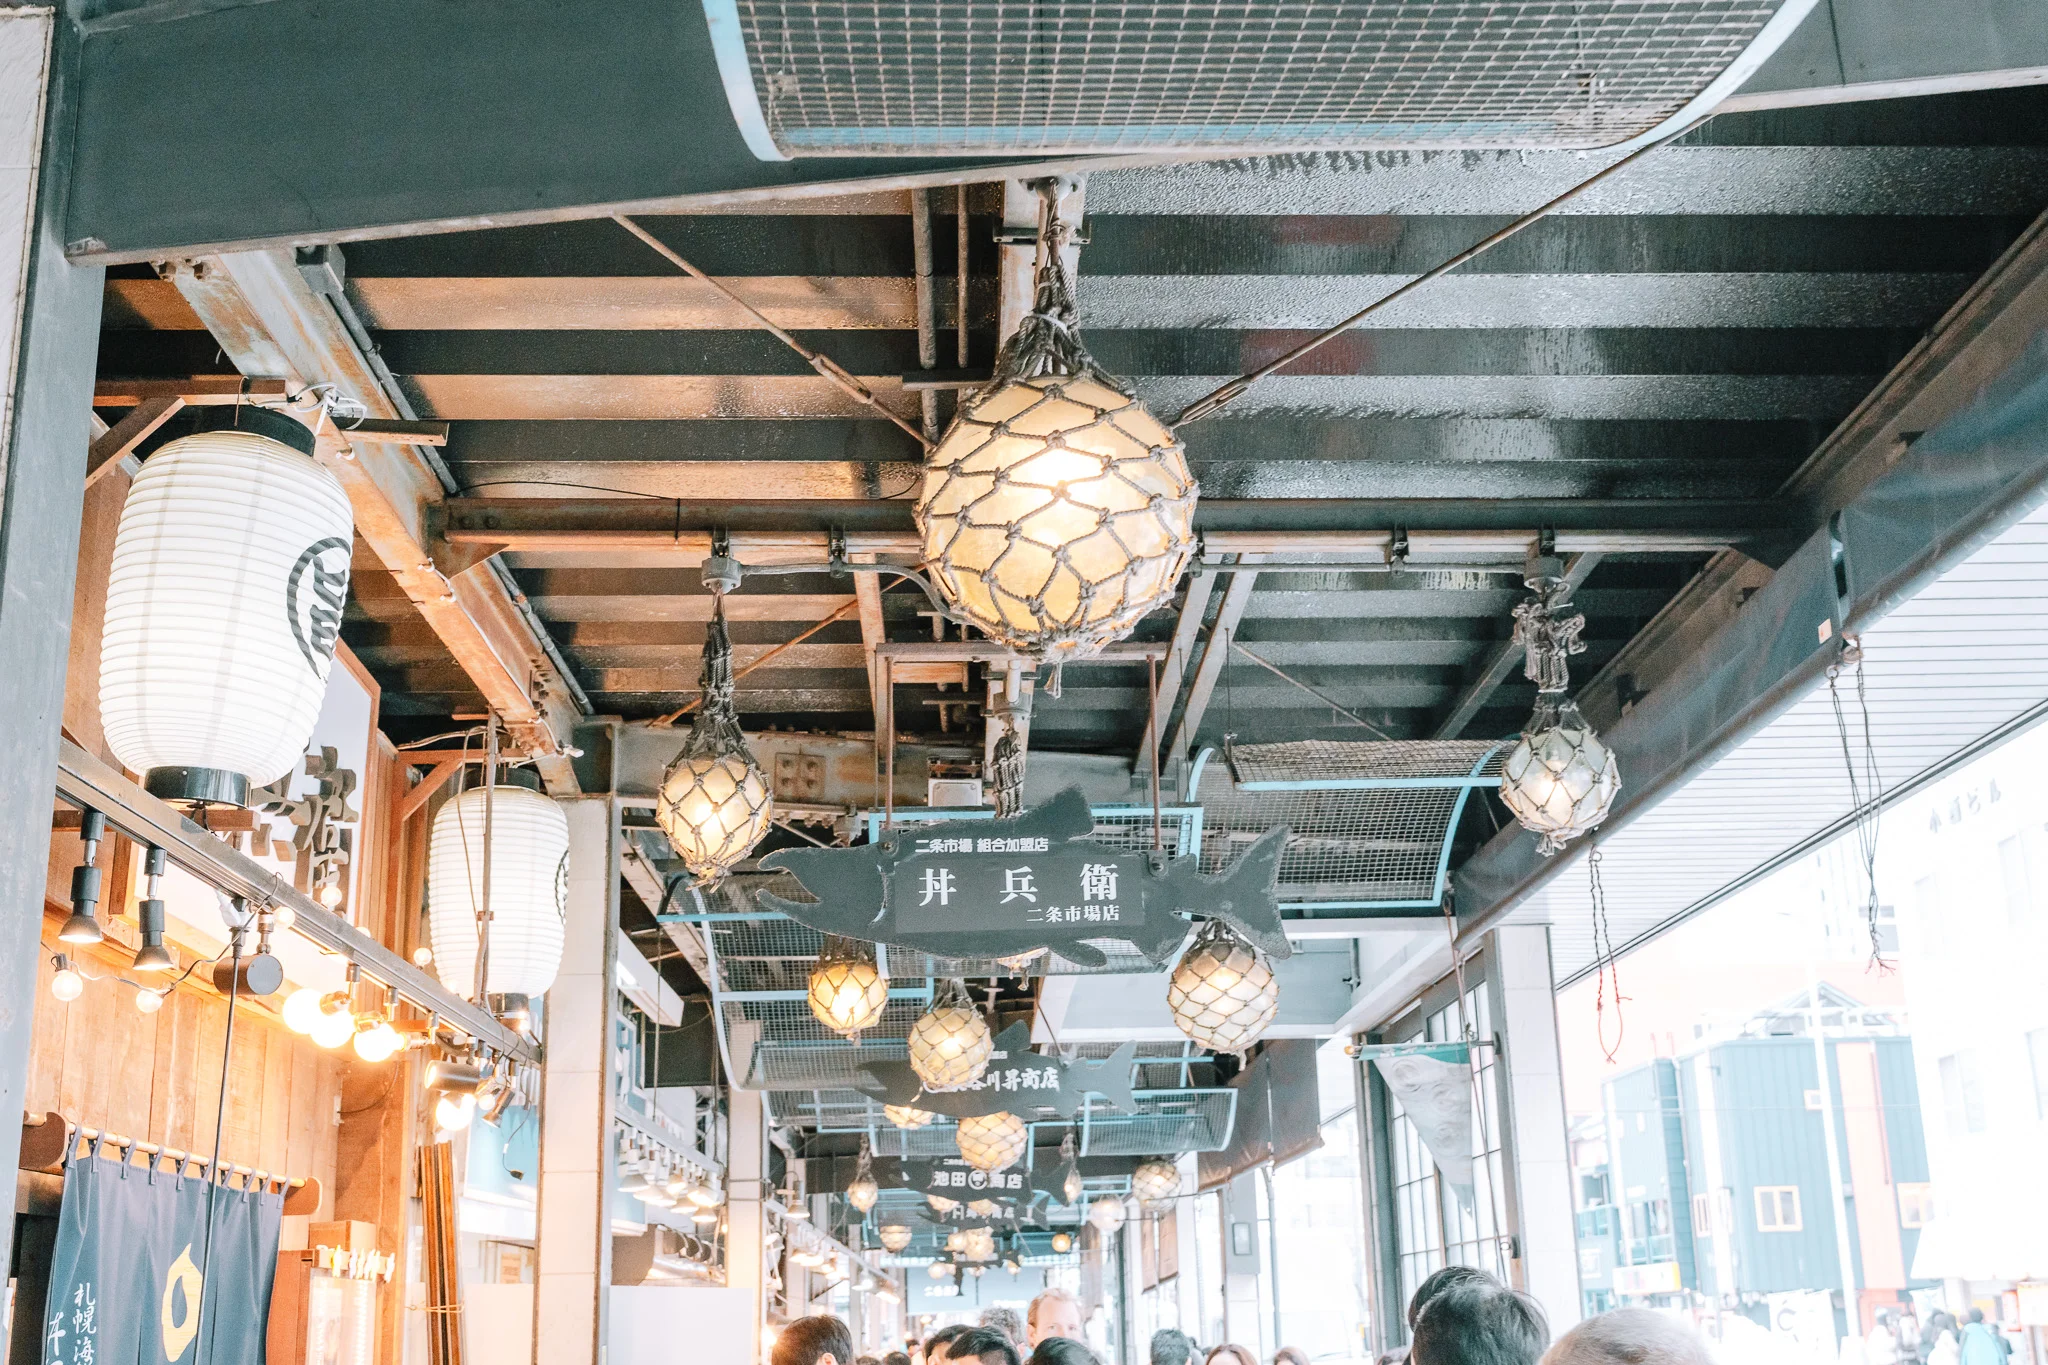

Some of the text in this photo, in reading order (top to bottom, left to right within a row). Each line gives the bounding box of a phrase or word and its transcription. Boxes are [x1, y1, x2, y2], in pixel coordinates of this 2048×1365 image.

[915, 837, 1049, 853] 二条市場 組合加盟店
[1026, 904, 1120, 923] 二条市場店
[72, 1282, 97, 1365] 札幌海
